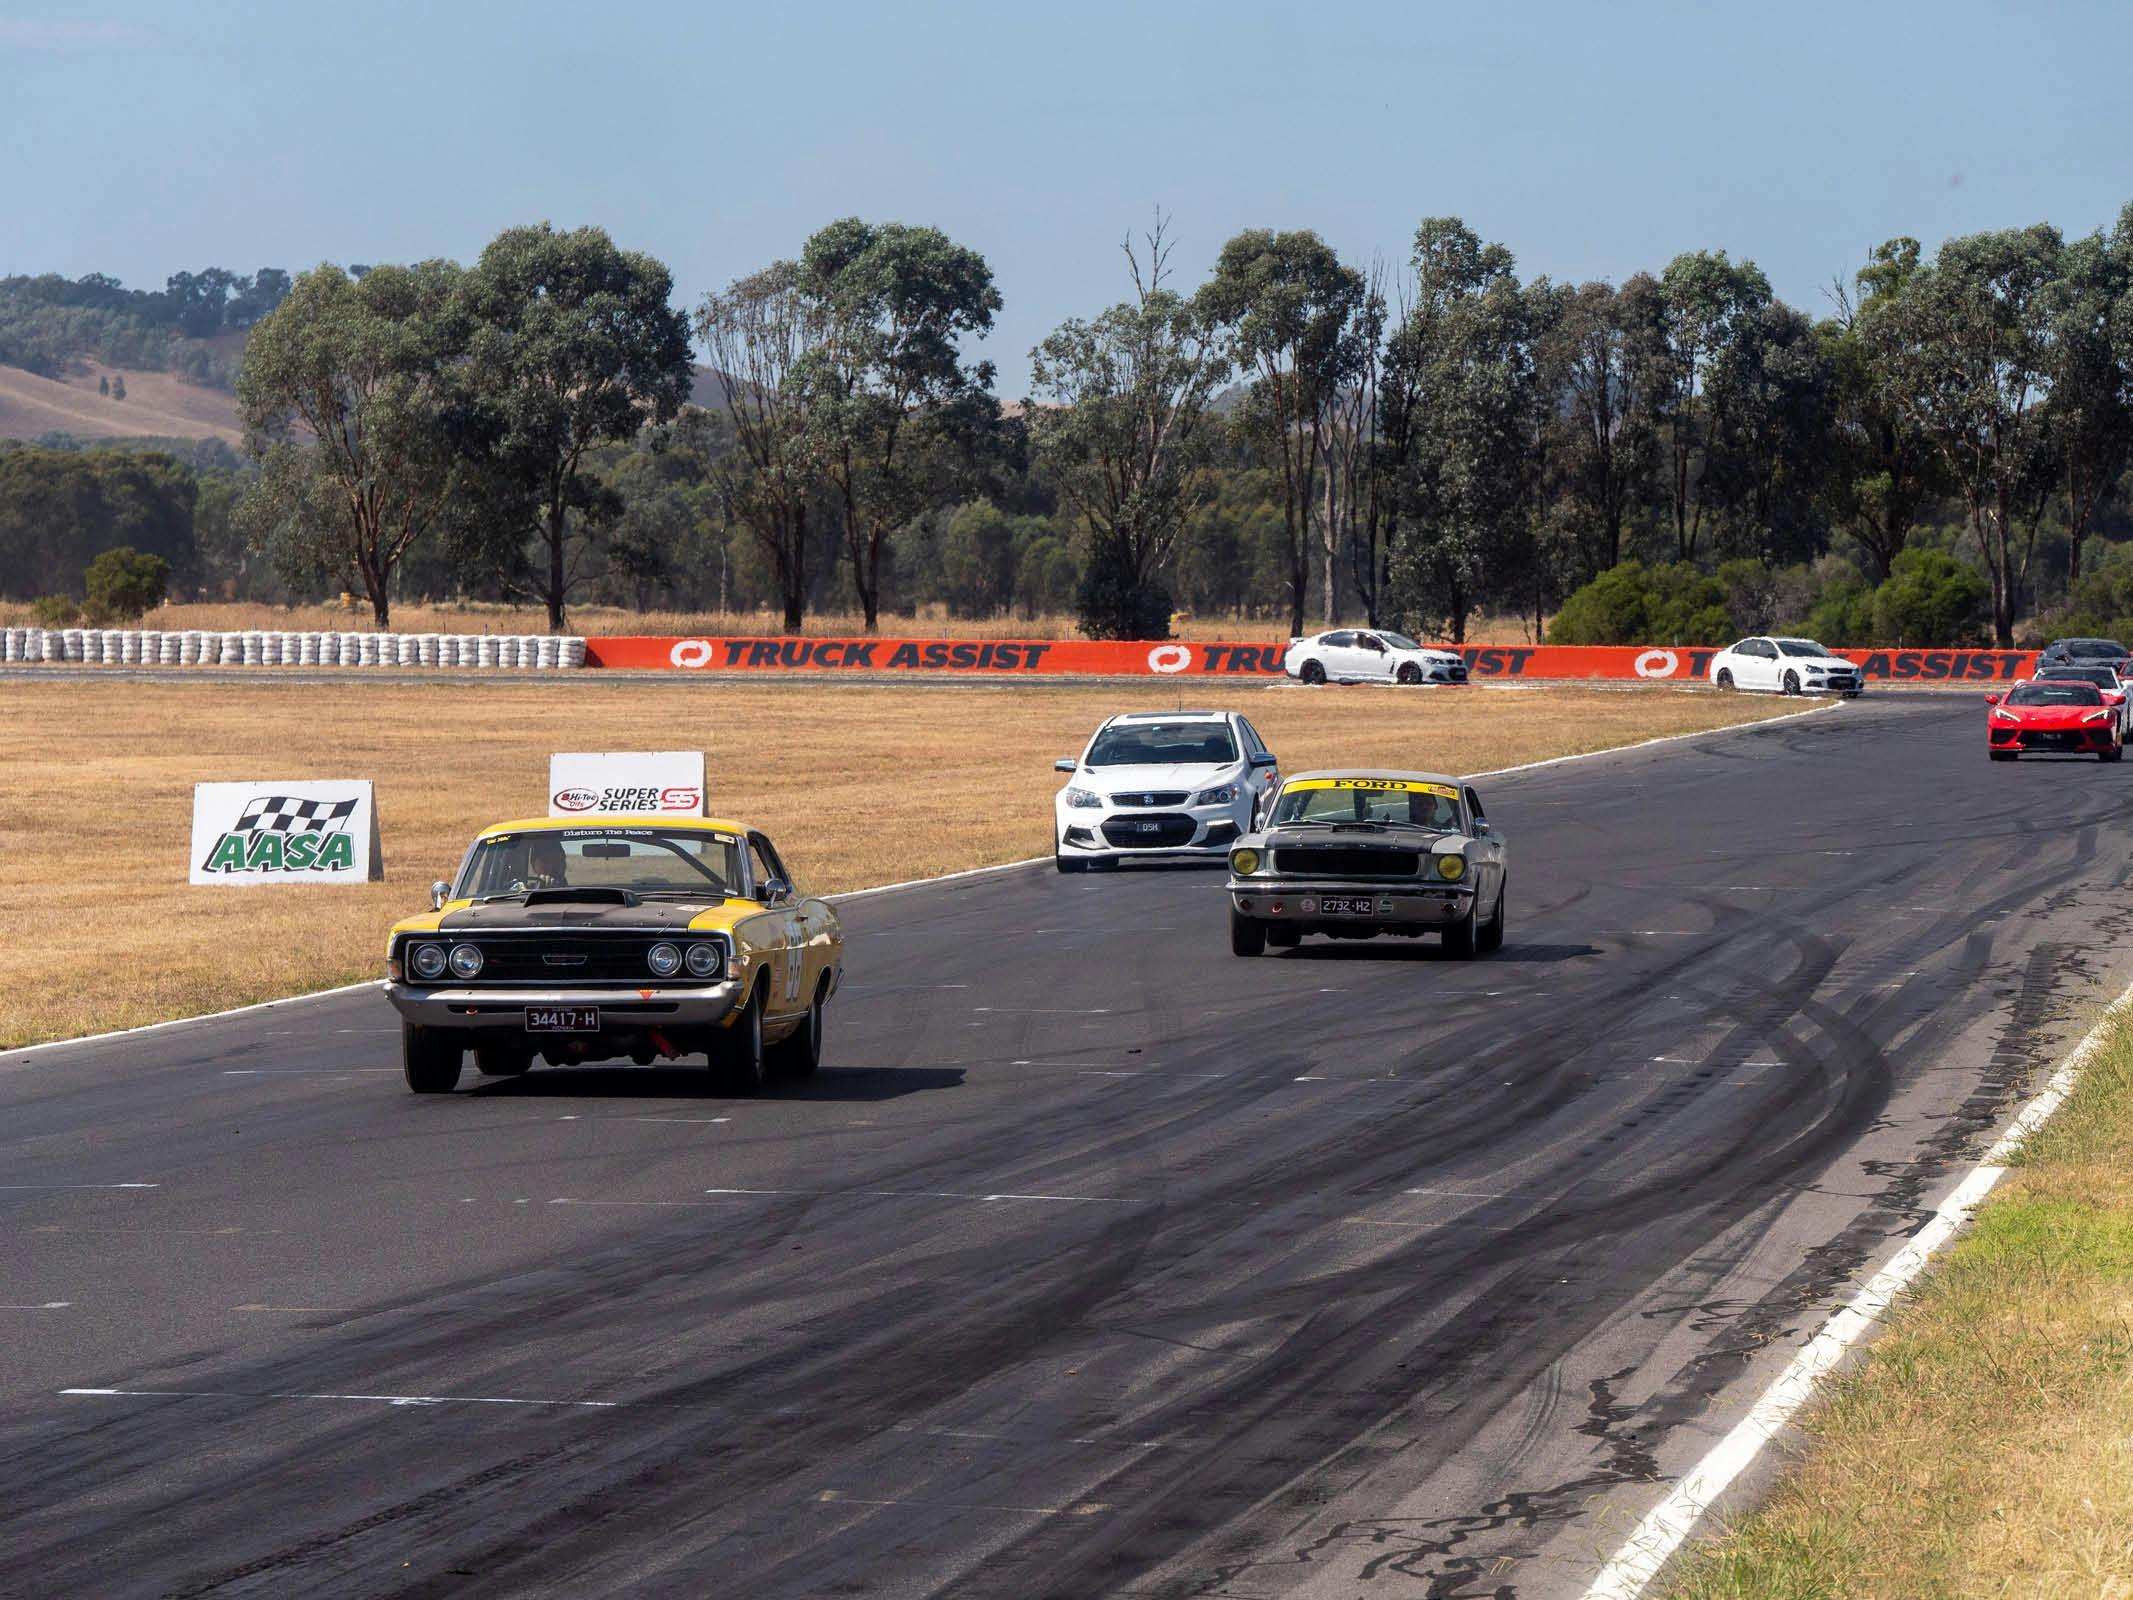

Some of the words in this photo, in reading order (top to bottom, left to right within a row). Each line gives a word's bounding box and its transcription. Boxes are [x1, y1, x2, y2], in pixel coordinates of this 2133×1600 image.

[724, 640, 879, 667] TRUCK
[889, 643, 1051, 669] ASSIST
[1202, 646, 1288, 672] TRU
[1864, 652, 2029, 681] ASSIST
[603, 788, 659, 799] SUPER
[1333, 780, 1408, 790] FORD
[570, 792, 597, 801] Hi-Tec
[598, 800, 659, 811] SERIES
[201, 830, 357, 874] AASA
